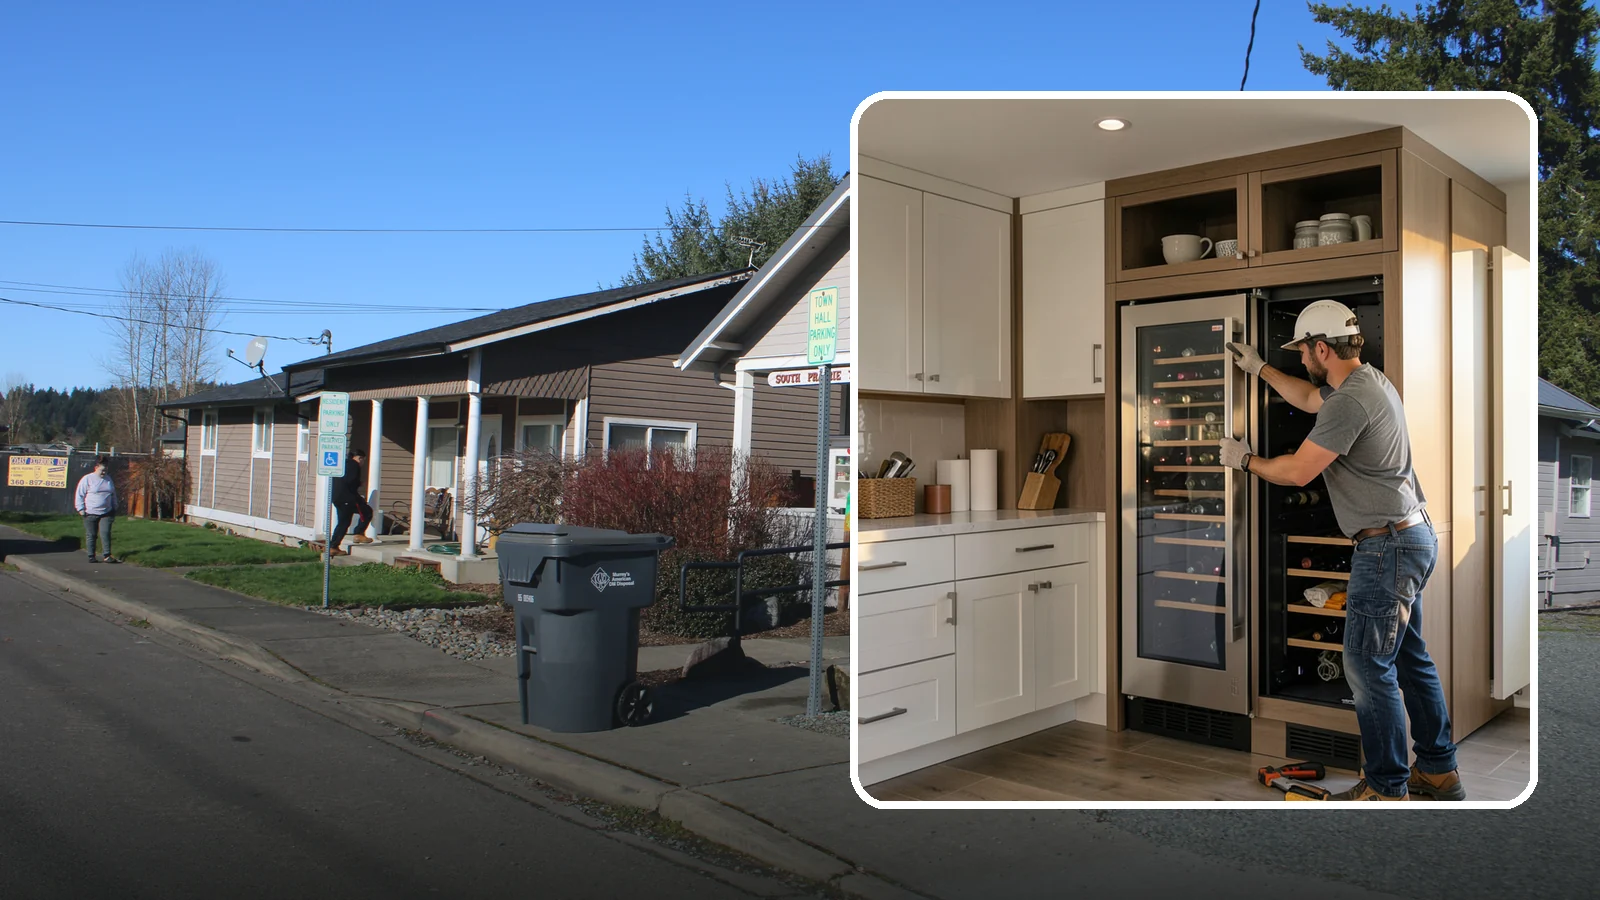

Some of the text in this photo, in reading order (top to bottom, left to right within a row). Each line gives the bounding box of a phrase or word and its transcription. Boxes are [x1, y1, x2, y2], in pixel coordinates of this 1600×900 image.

[815, 295, 833, 308] TOWN
[814, 312, 831, 325] HALL
[810, 327, 836, 341] PARKING
[814, 344, 831, 357] ONLY
[775, 373, 801, 384] SOUTH
[808, 370, 842, 382] PRIE
